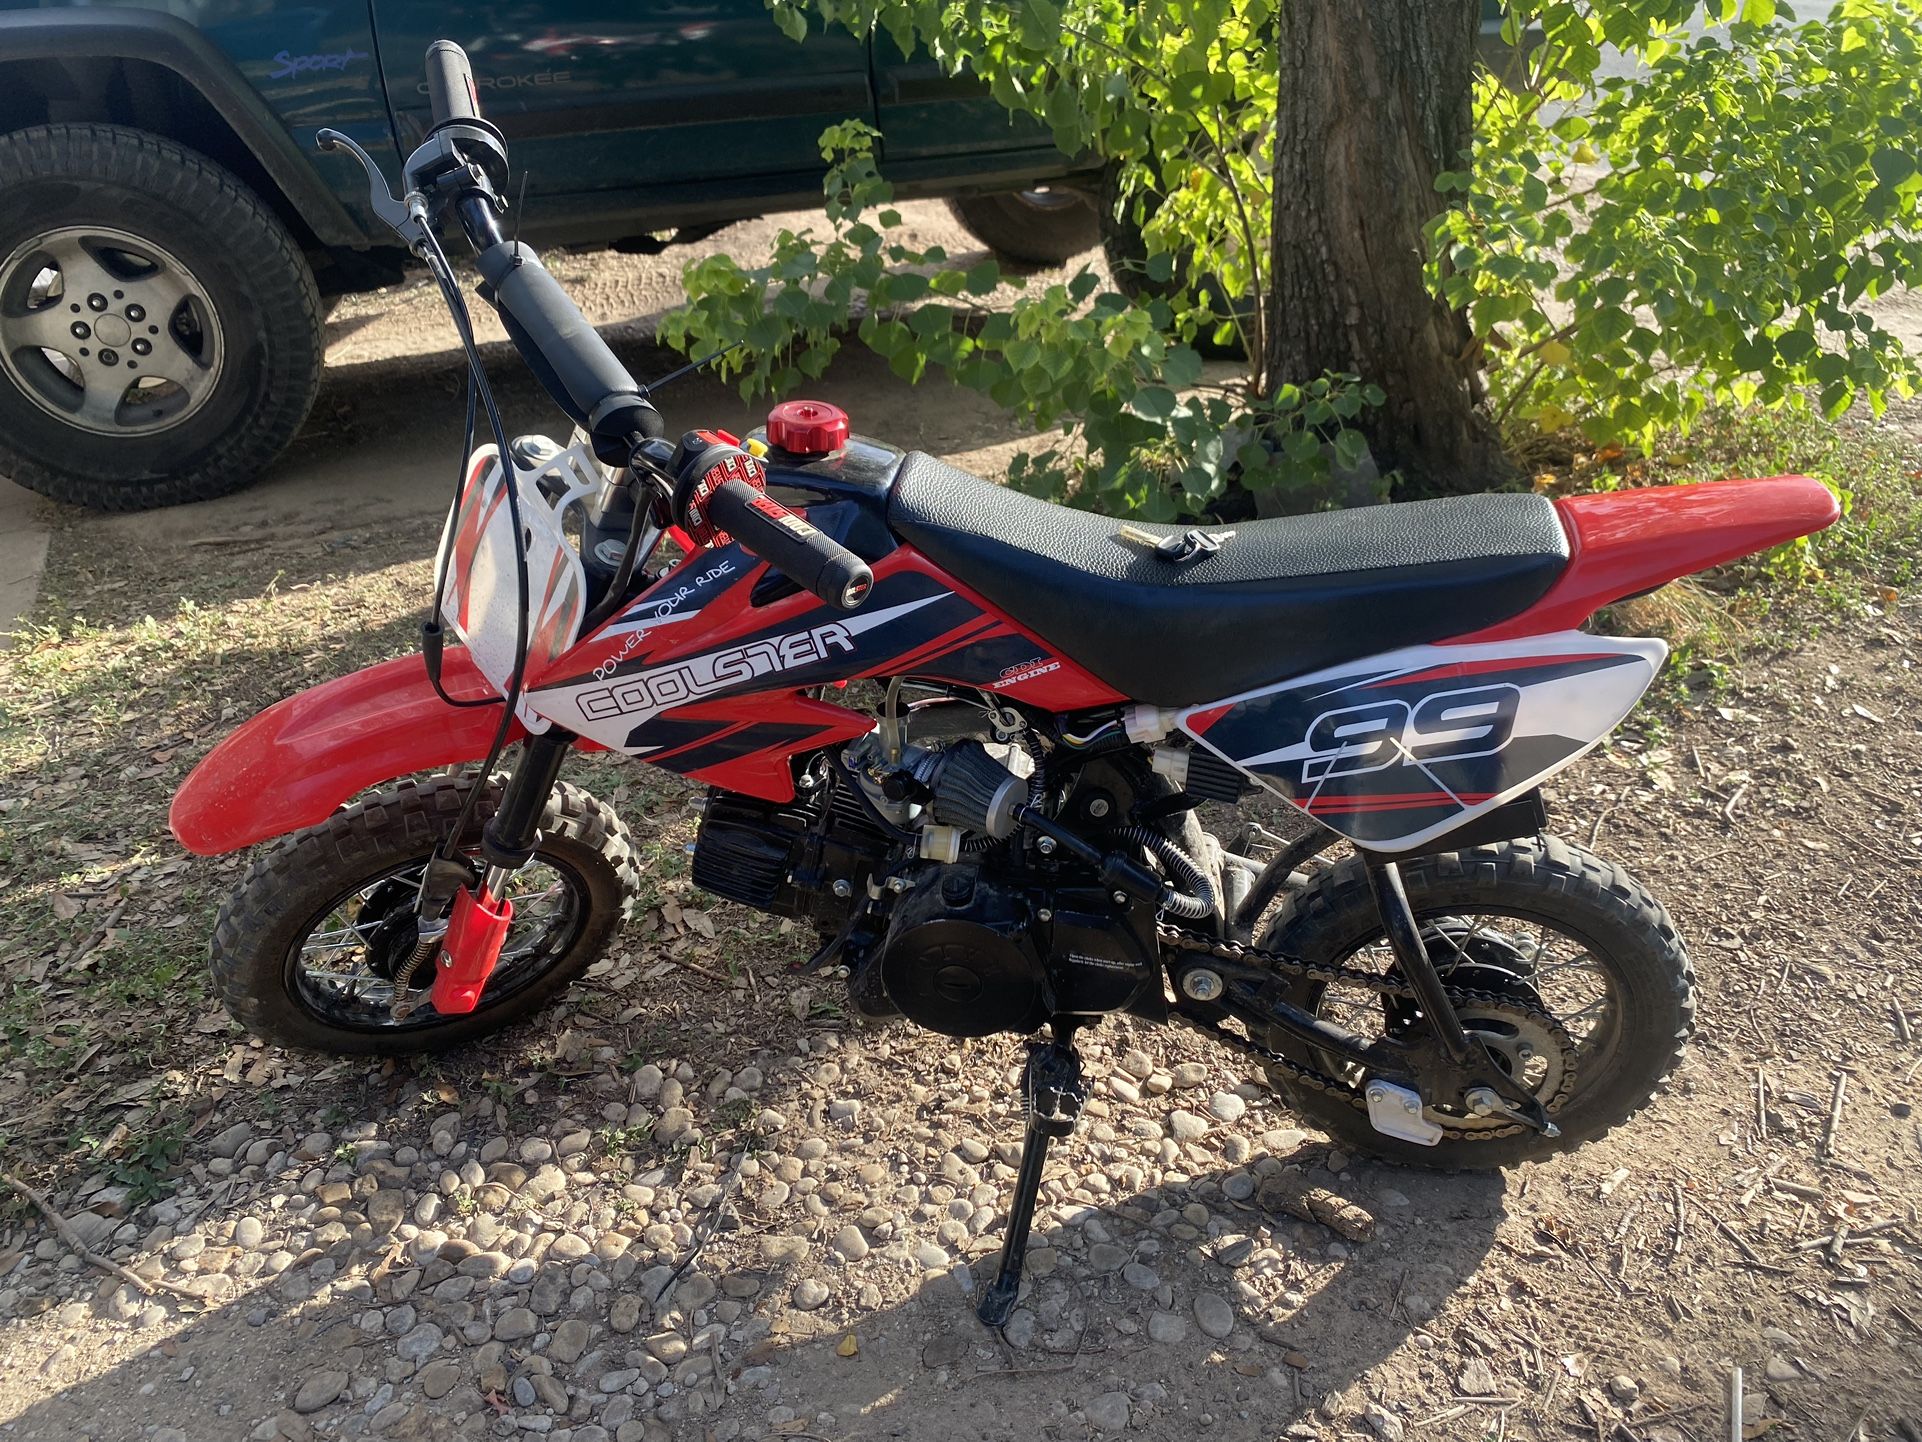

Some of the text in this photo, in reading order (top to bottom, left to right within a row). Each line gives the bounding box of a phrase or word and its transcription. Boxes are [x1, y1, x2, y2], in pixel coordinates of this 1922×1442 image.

[416, 71, 572, 95] CROKEE
[592, 560, 735, 681] POWER YOUR RIDE
[575, 621, 857, 722] COOLSTER
[992, 661, 1061, 689] ENGINE
[1000, 657, 1044, 679] CDI
[1301, 682, 1523, 784] 99
